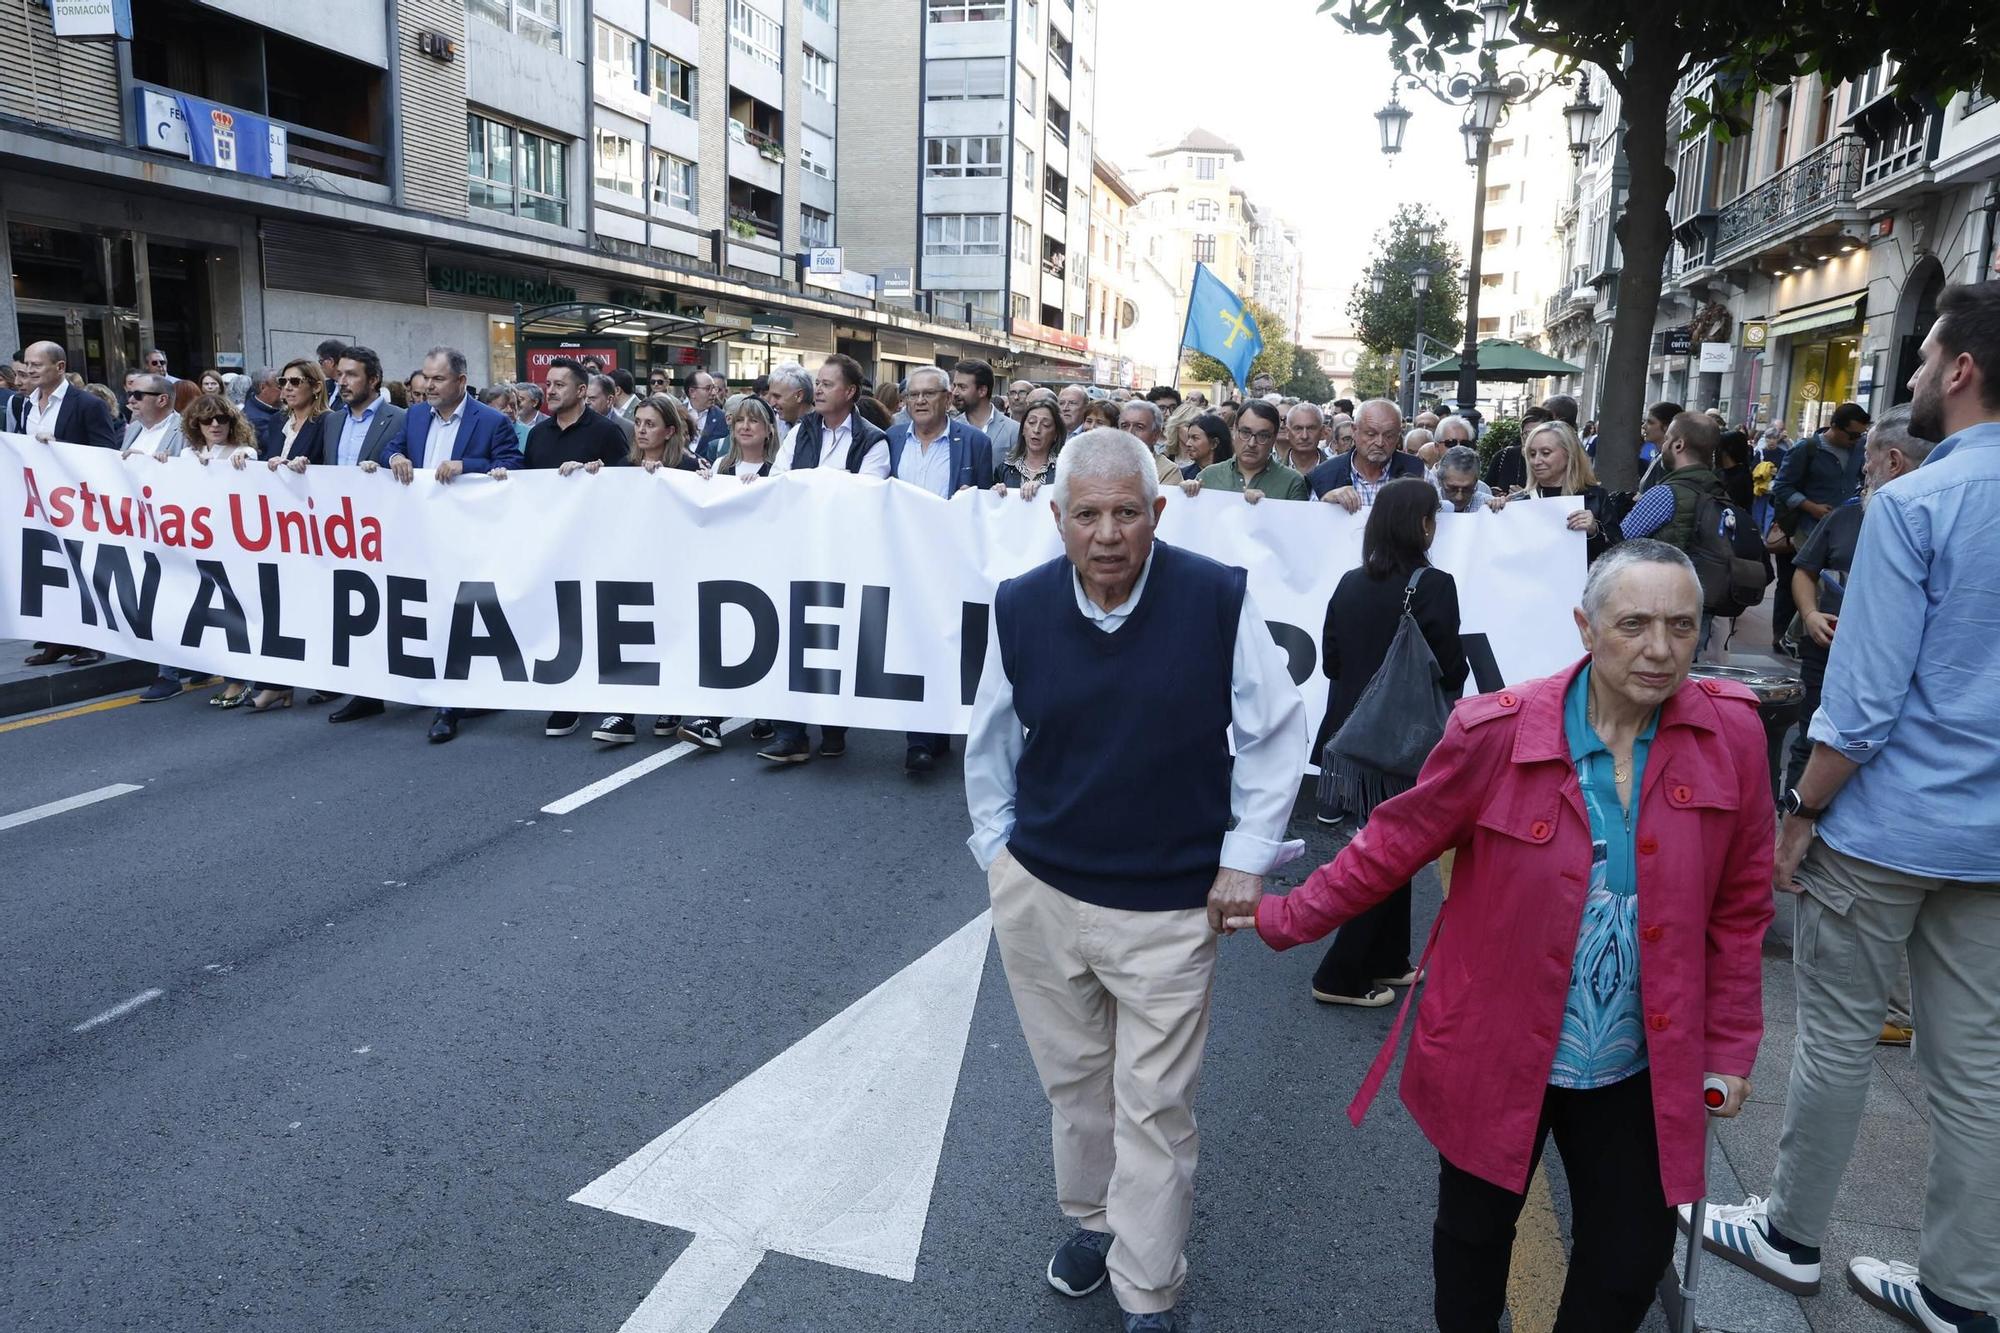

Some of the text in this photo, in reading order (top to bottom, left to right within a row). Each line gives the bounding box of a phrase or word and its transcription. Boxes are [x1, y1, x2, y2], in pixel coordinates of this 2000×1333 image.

[57, 3, 110, 15] FORMACIÓN
[817, 257, 835, 266] FORO
[440, 266, 576, 303] SUPERMERCADO
[23, 467, 383, 562] Asturias Unida
[332, 569, 660, 686] PEAJE
[697, 580, 924, 702] DEL
